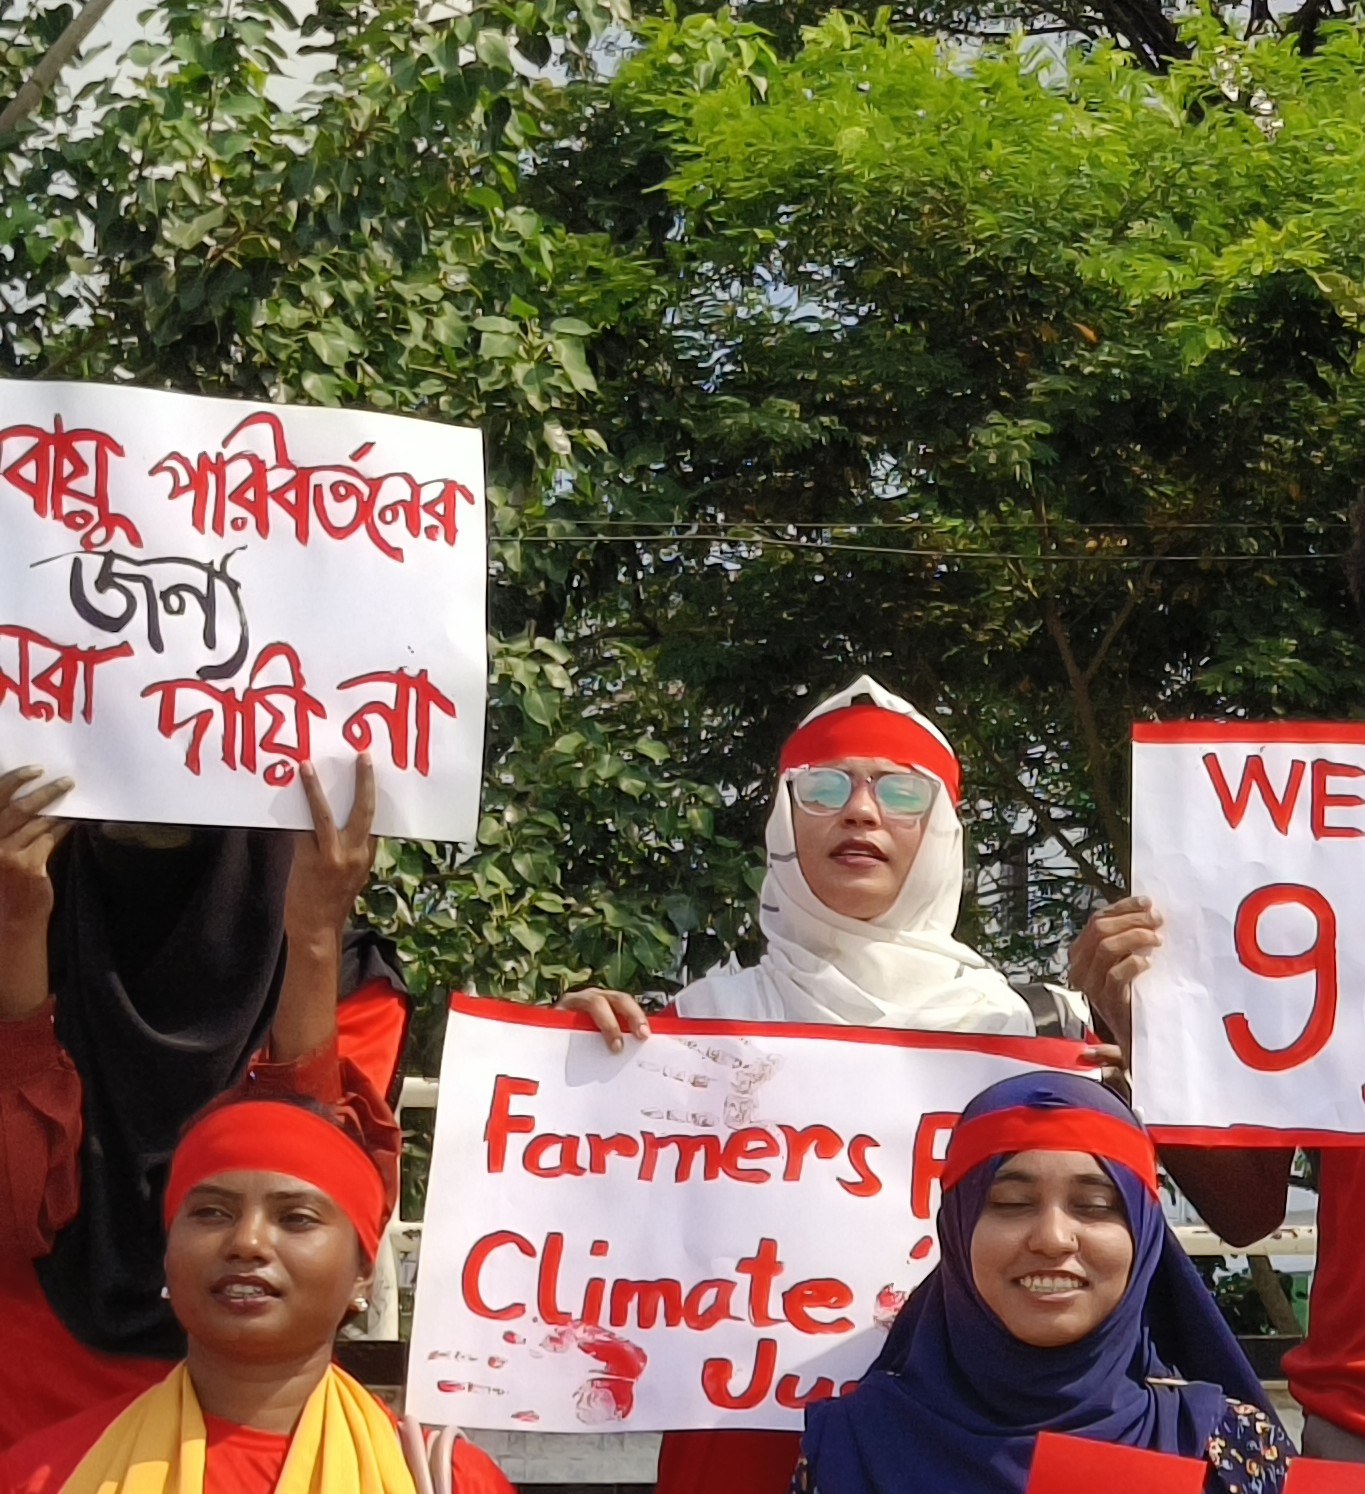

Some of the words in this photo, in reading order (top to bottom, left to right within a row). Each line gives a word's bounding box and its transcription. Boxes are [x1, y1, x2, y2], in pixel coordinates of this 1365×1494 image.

[0, 412, 143, 551] বায়ু
[30, 546, 249, 679] জন্য
[337, 667, 456, 777] না
[484, 1074, 882, 1197] Farmers
[462, 1230, 855, 1335] Climate
